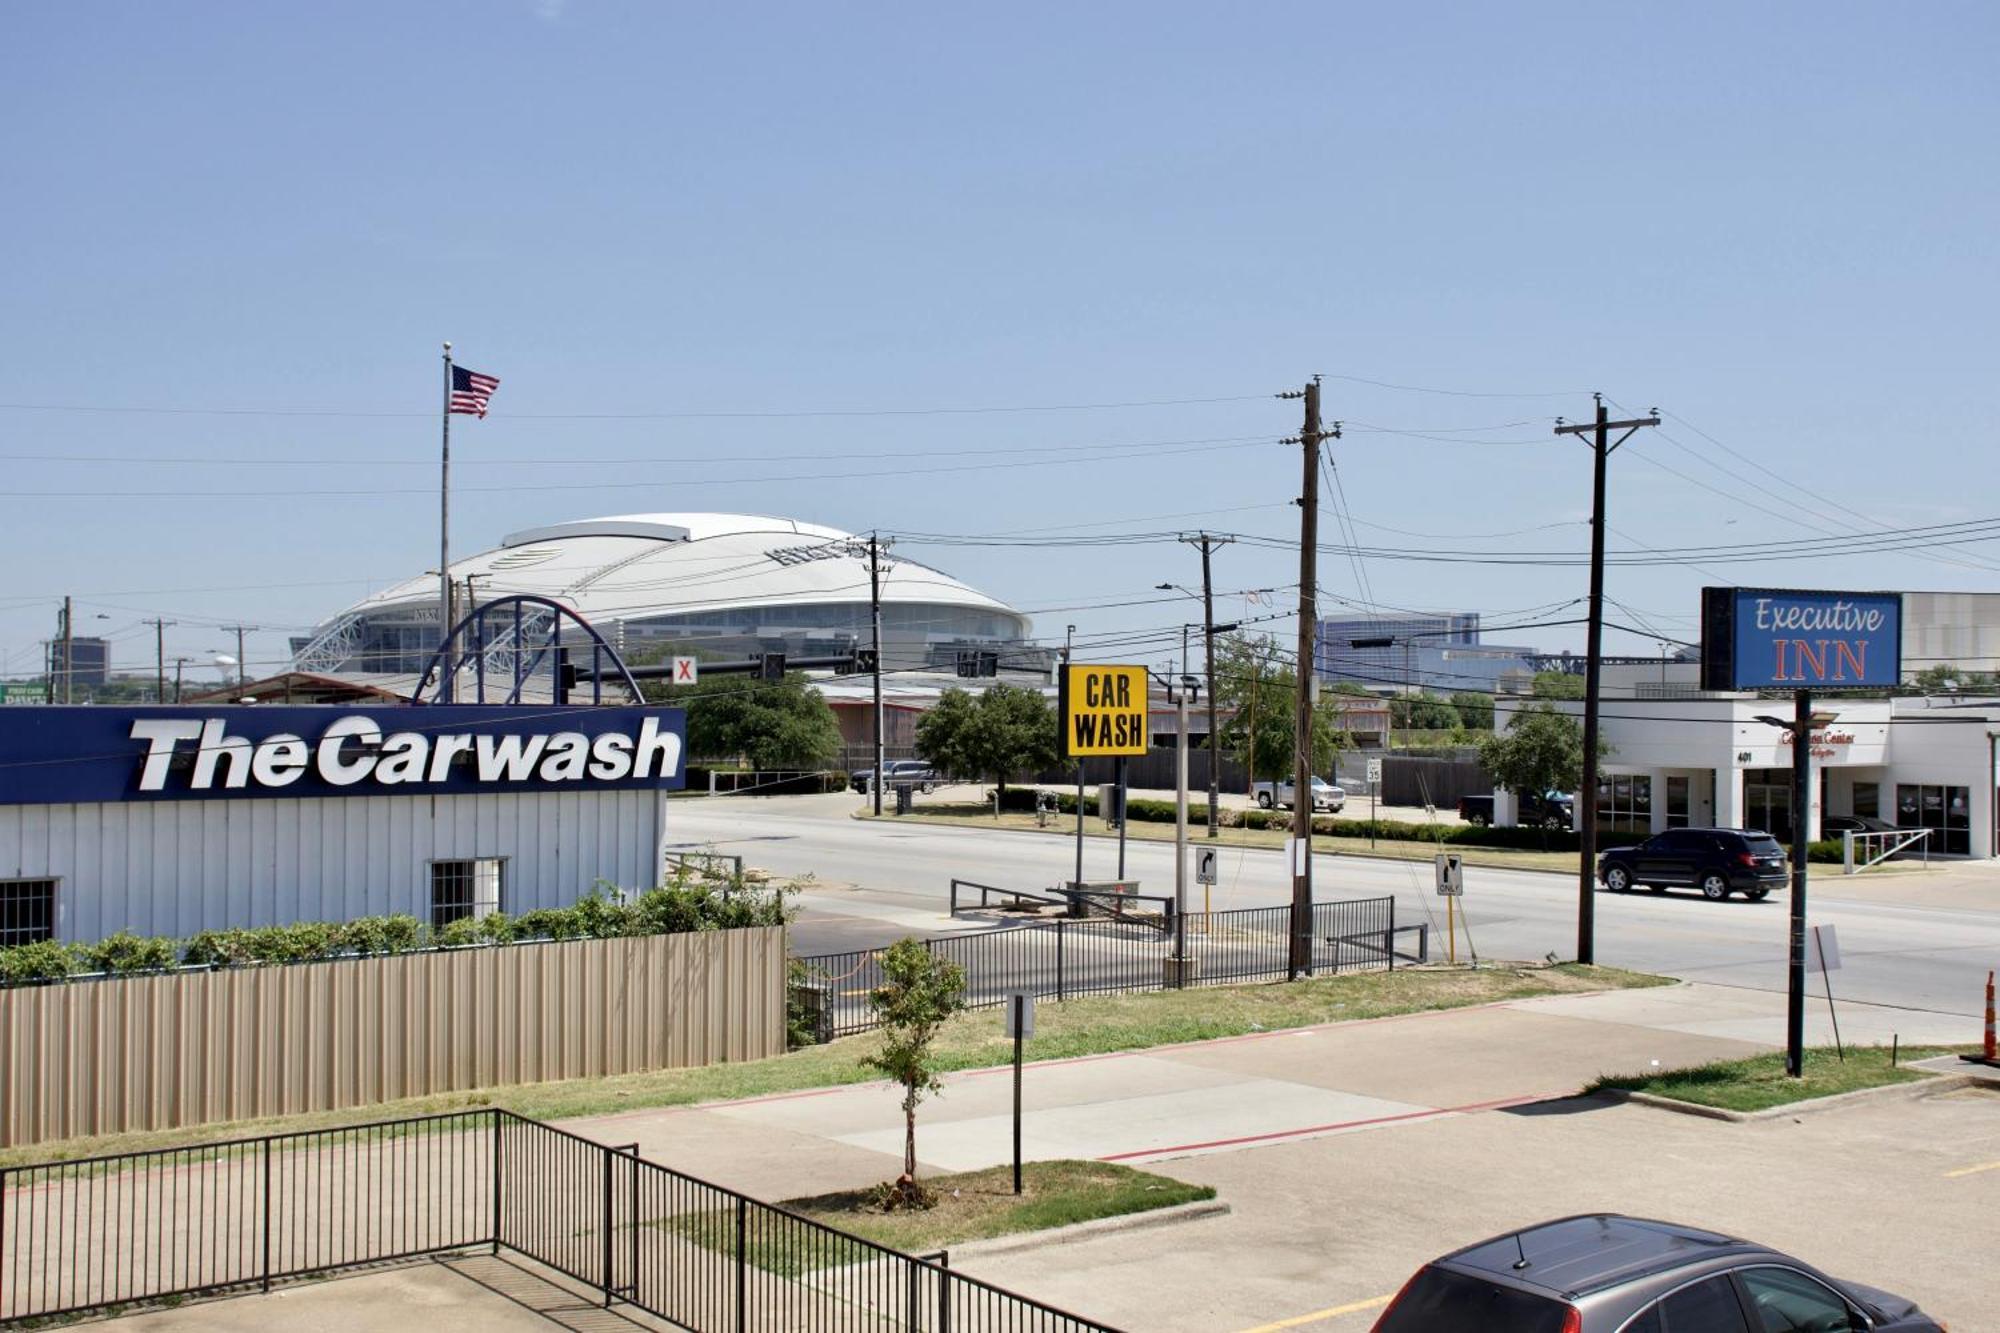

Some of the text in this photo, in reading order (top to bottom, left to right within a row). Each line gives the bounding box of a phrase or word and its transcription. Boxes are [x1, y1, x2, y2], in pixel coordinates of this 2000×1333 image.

[1755, 598, 1885, 632] Executive
[1772, 639, 1869, 680] INN
[1086, 674, 1130, 707] CAR
[1074, 714, 1142, 747] WASH
[1737, 752, 1752, 763] 401
[1368, 771, 1379, 780] 35
[1440, 884, 1460, 893] ONLY
